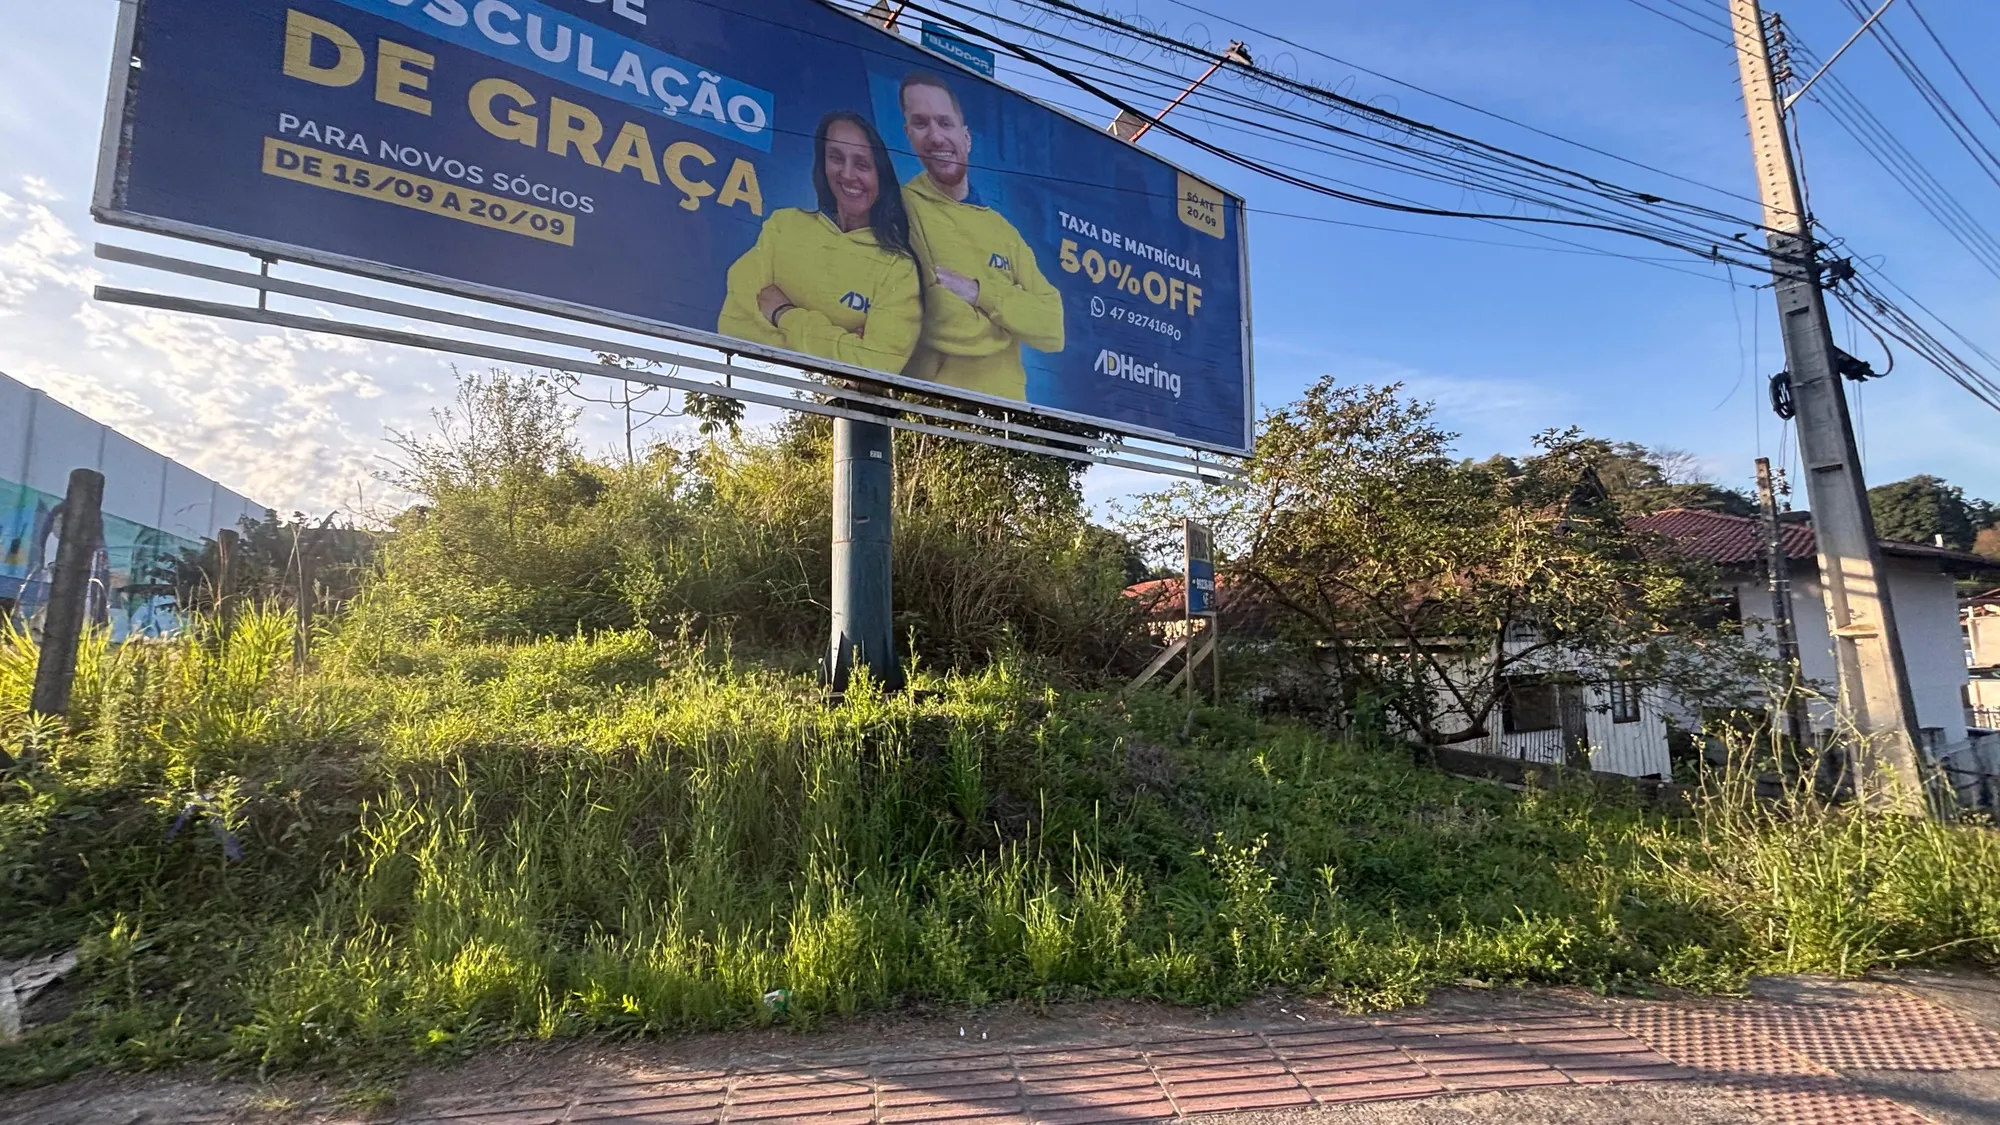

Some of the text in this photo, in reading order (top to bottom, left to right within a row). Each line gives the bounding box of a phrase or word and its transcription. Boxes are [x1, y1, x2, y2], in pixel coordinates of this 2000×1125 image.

[387, 0, 766, 132] SCULAÇÃO
[283, 9, 763, 216] DE GRAÇA
[275, 148, 565, 236] DE 15/09 A 20/09
[279, 113, 595, 213] PARA NOVOS SÓCIOS
[1058, 211, 1201, 278] TAXA DE MATRÍCULA
[1187, 206, 1217, 227] 20/09
[1109, 306, 1125, 321] 47
[1094, 349, 1181, 398] ADHering
